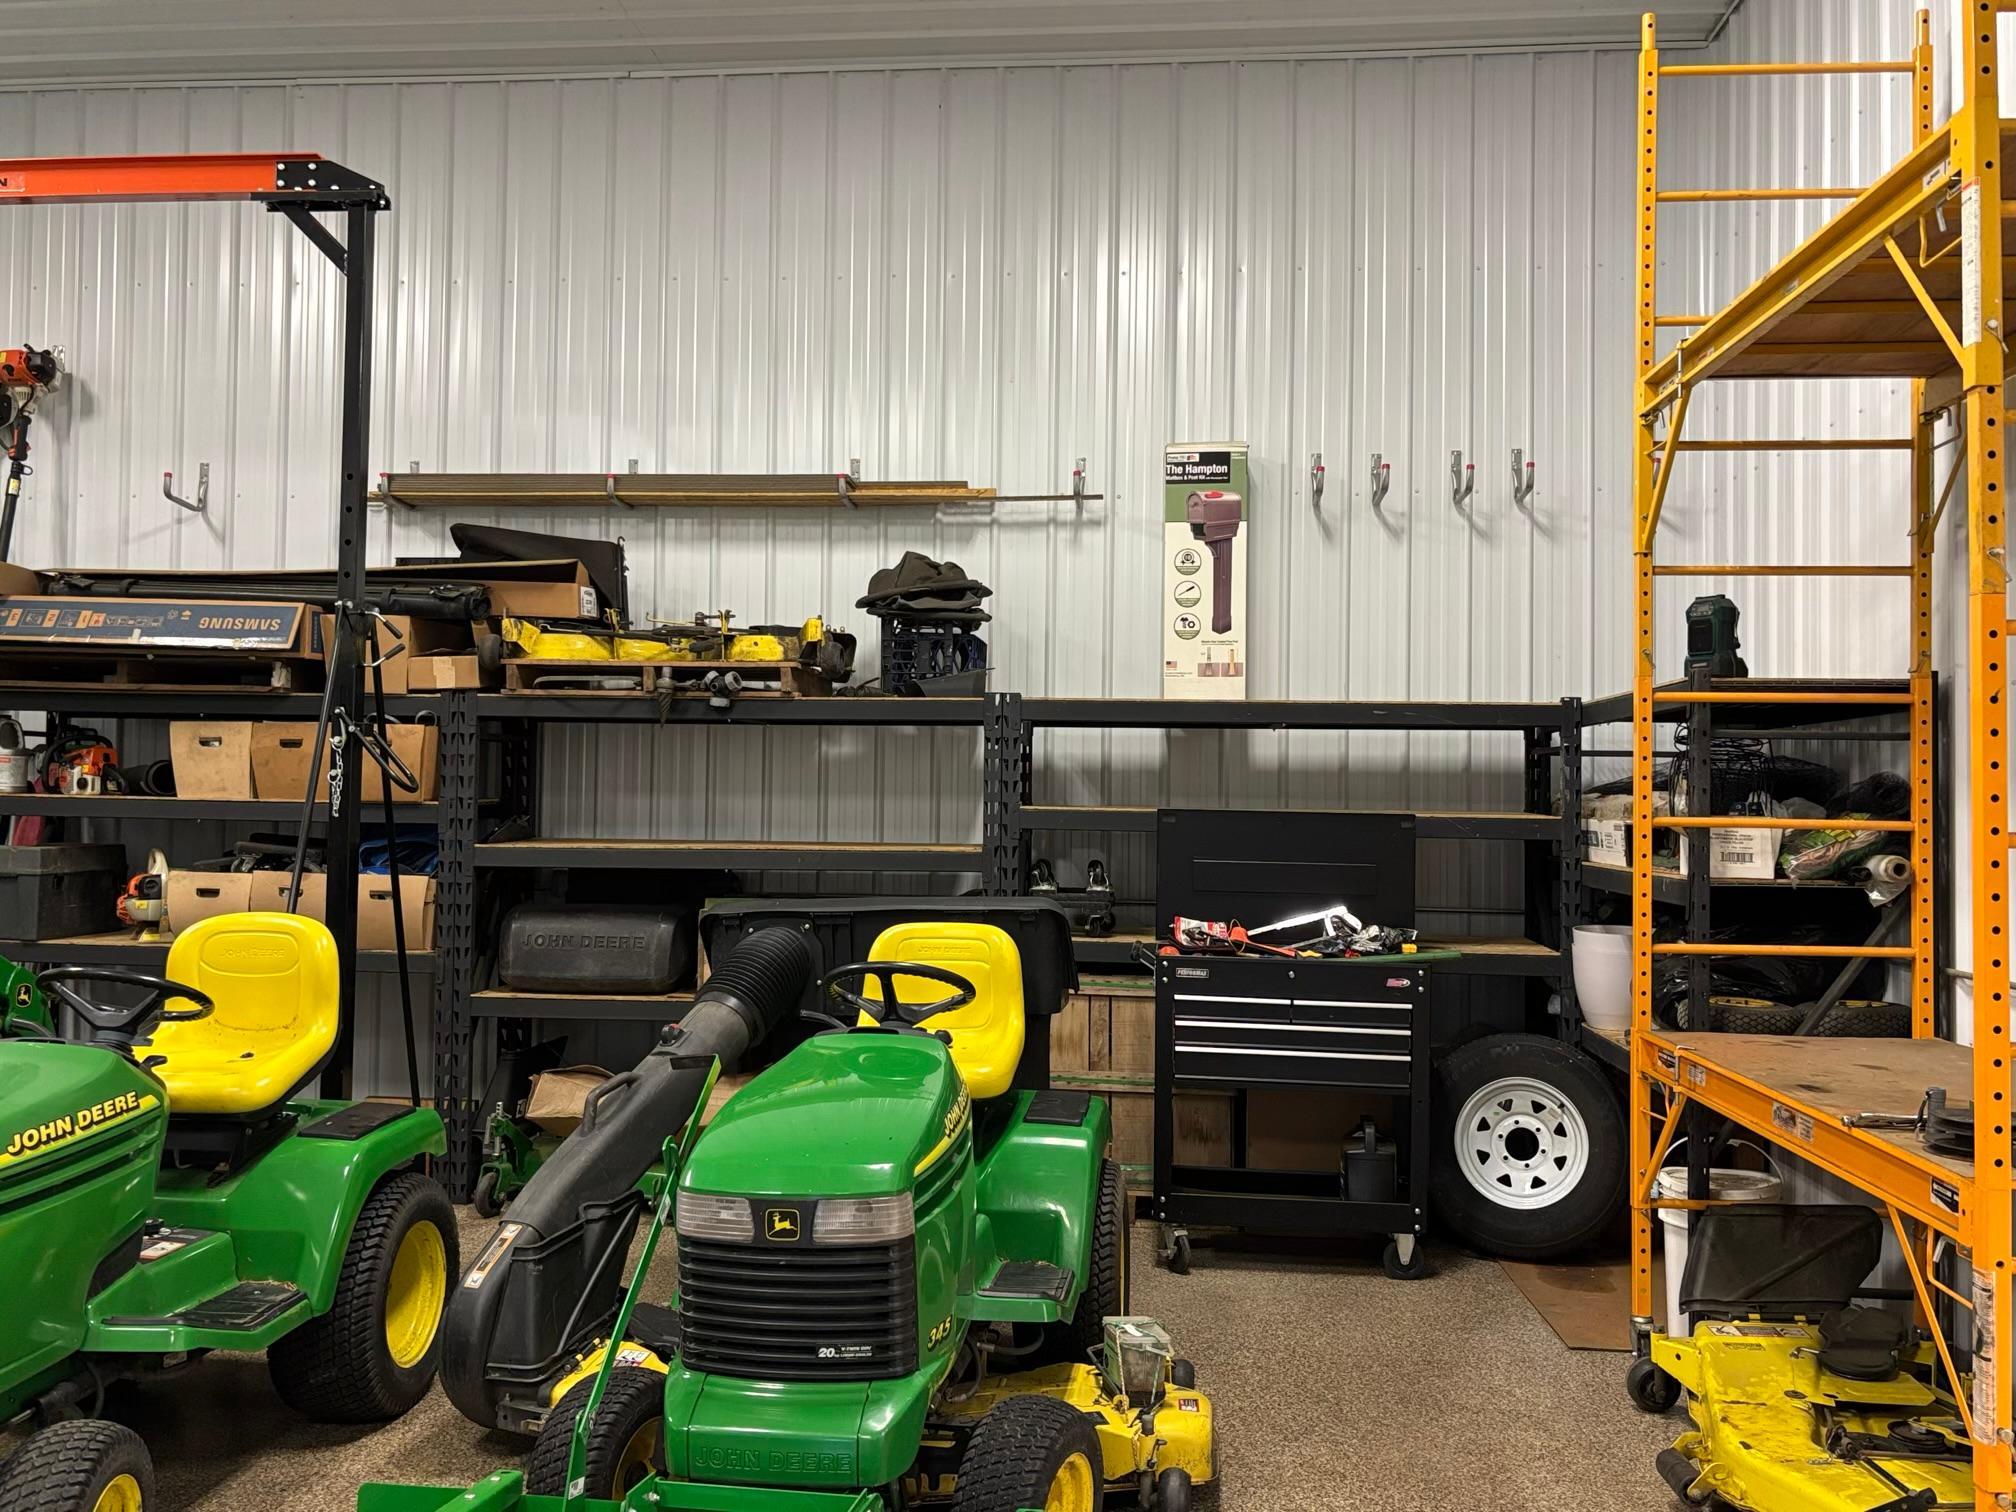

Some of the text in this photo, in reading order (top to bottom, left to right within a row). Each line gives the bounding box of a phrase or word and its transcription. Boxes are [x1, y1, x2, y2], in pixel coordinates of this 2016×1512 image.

[1166, 464, 1228, 475] The Hampton
[198, 617, 281, 631] SAMSUNG
[522, 934, 646, 949] JOHN DEERE
[7, 1091, 139, 1155] JOHN DEERE
[944, 1102, 961, 1137] JOHN
[928, 1316, 952, 1350] 345
[818, 1347, 835, 1358] 20
[696, 1448, 852, 1473] JOHN DEERE
